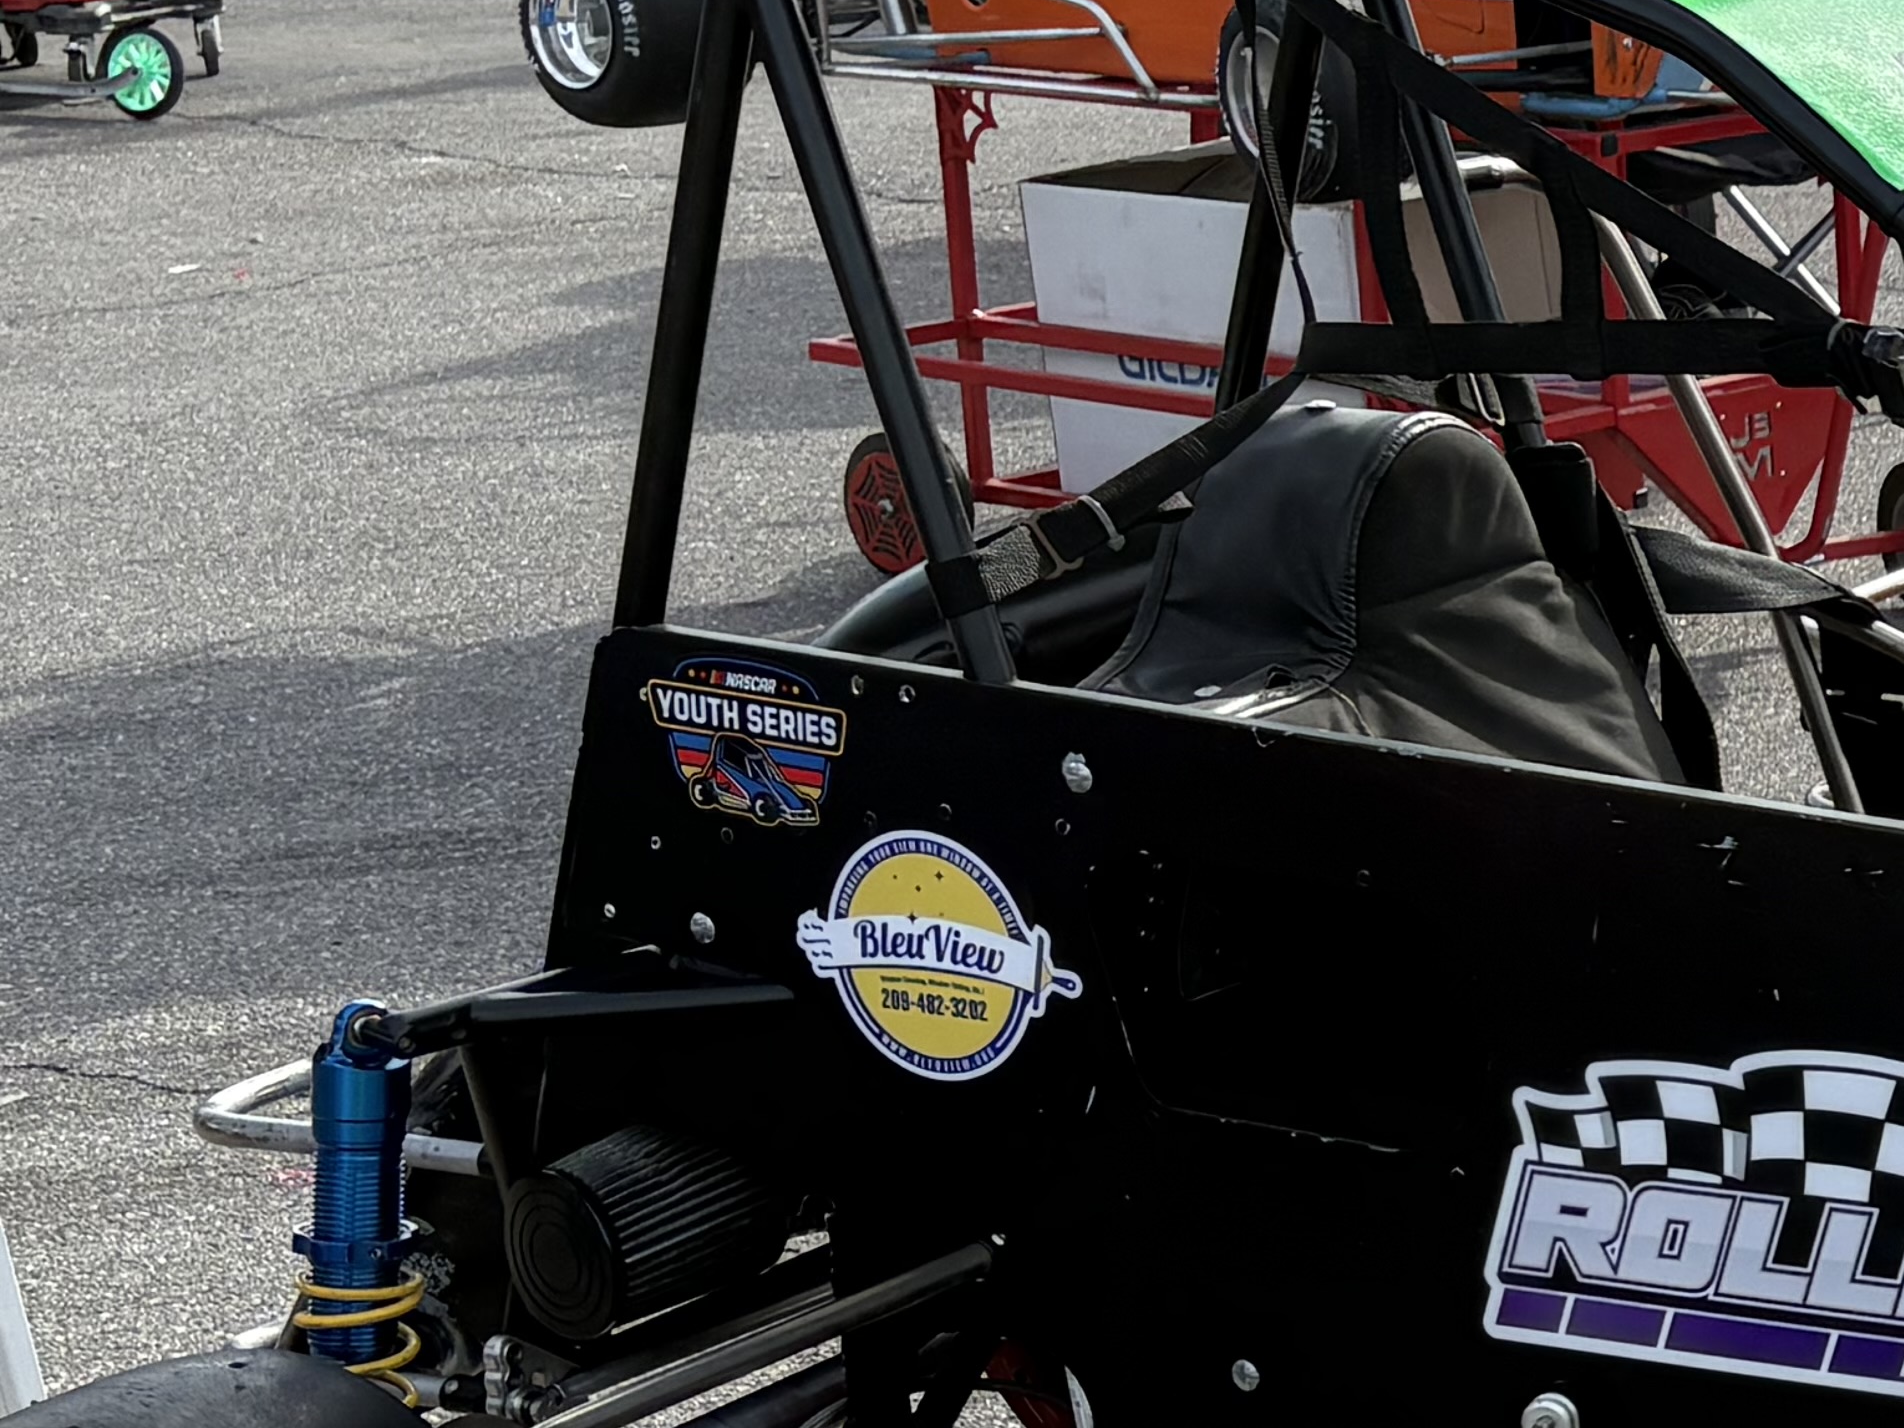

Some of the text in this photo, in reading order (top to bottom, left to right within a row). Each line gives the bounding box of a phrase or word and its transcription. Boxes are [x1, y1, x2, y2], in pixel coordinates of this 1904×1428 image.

[724, 672, 777, 694] NASCAR
[656, 687, 838, 746] YOUTH SERIES
[853, 917, 1006, 974] BleuView
[879, 987, 989, 1023] 209-482-3202
